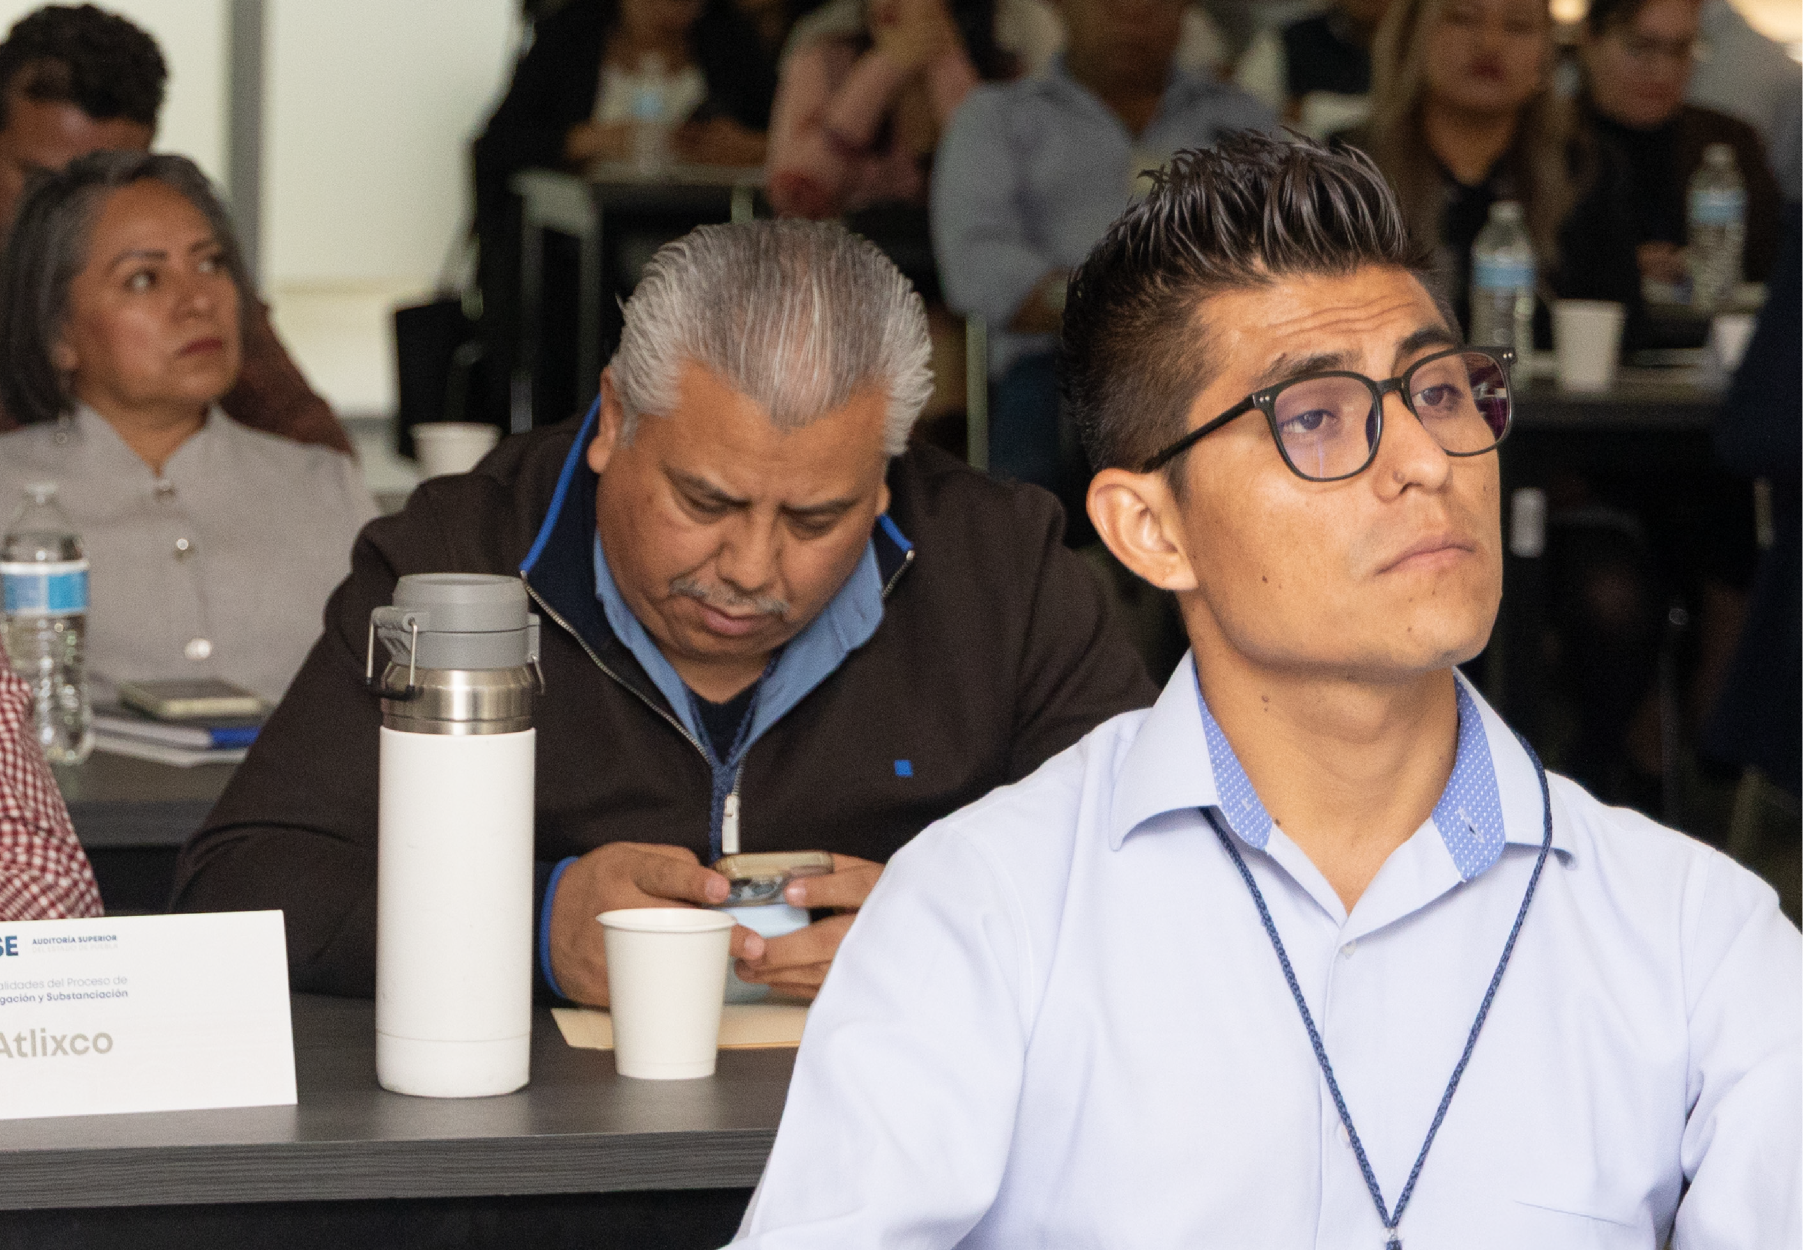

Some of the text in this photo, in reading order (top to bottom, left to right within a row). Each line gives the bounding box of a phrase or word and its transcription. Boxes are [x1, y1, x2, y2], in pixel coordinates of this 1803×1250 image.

[32, 935, 117, 945] AUDITORÍA SUPERIOR
[47, 978, 64, 989] del
[67, 977, 110, 988] Proceso
[113, 975, 128, 985] de
[38, 994, 44, 1003] y
[46, 989, 128, 1001] Substanciación
